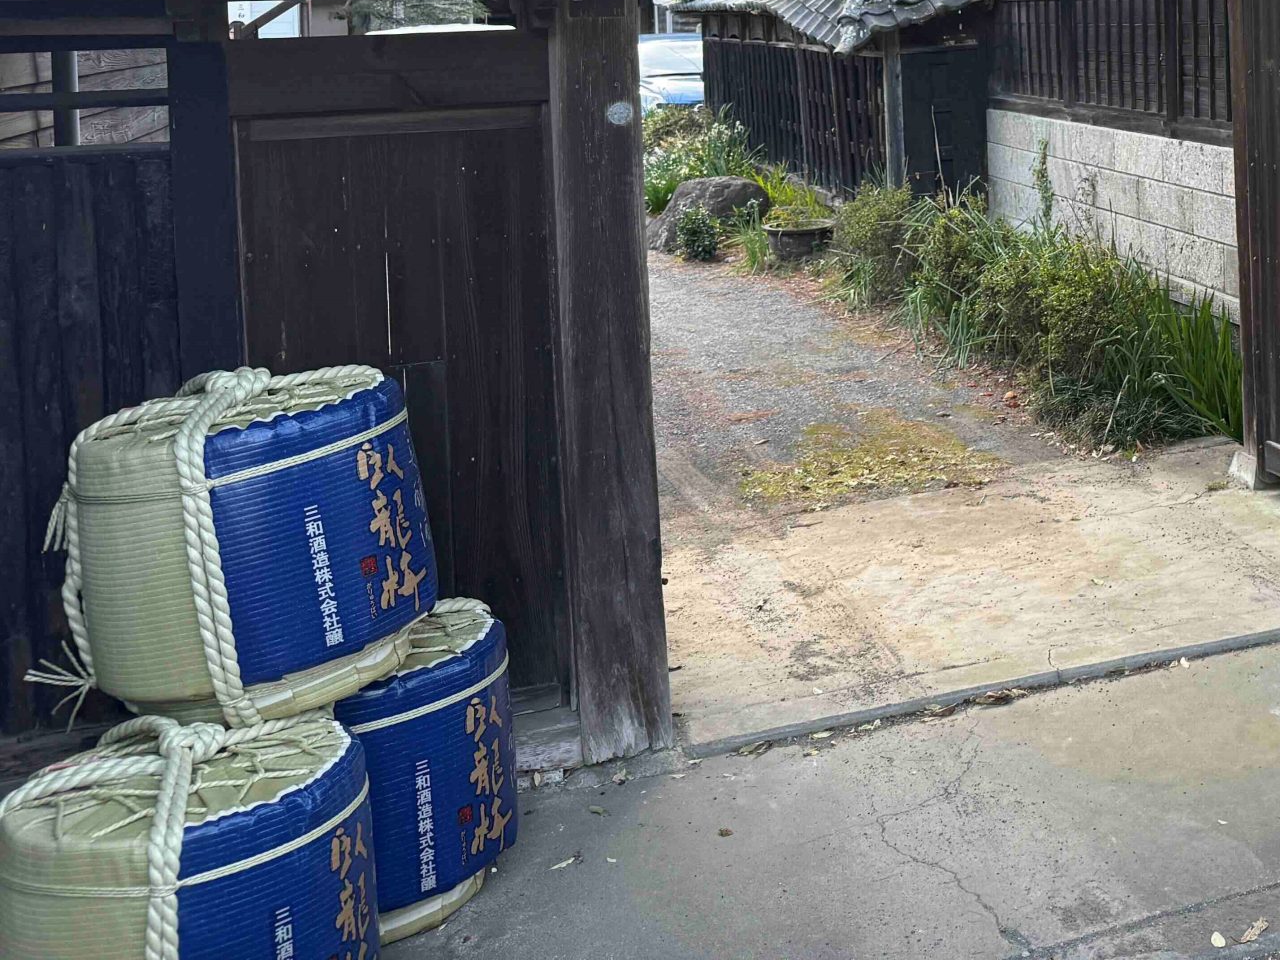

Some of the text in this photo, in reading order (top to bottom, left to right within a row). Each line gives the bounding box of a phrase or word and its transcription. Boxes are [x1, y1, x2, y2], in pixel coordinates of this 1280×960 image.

[304, 504, 345, 647] 三和酒造株式会社醸
[415, 759, 437, 892] 三和酒造株式会社醸
